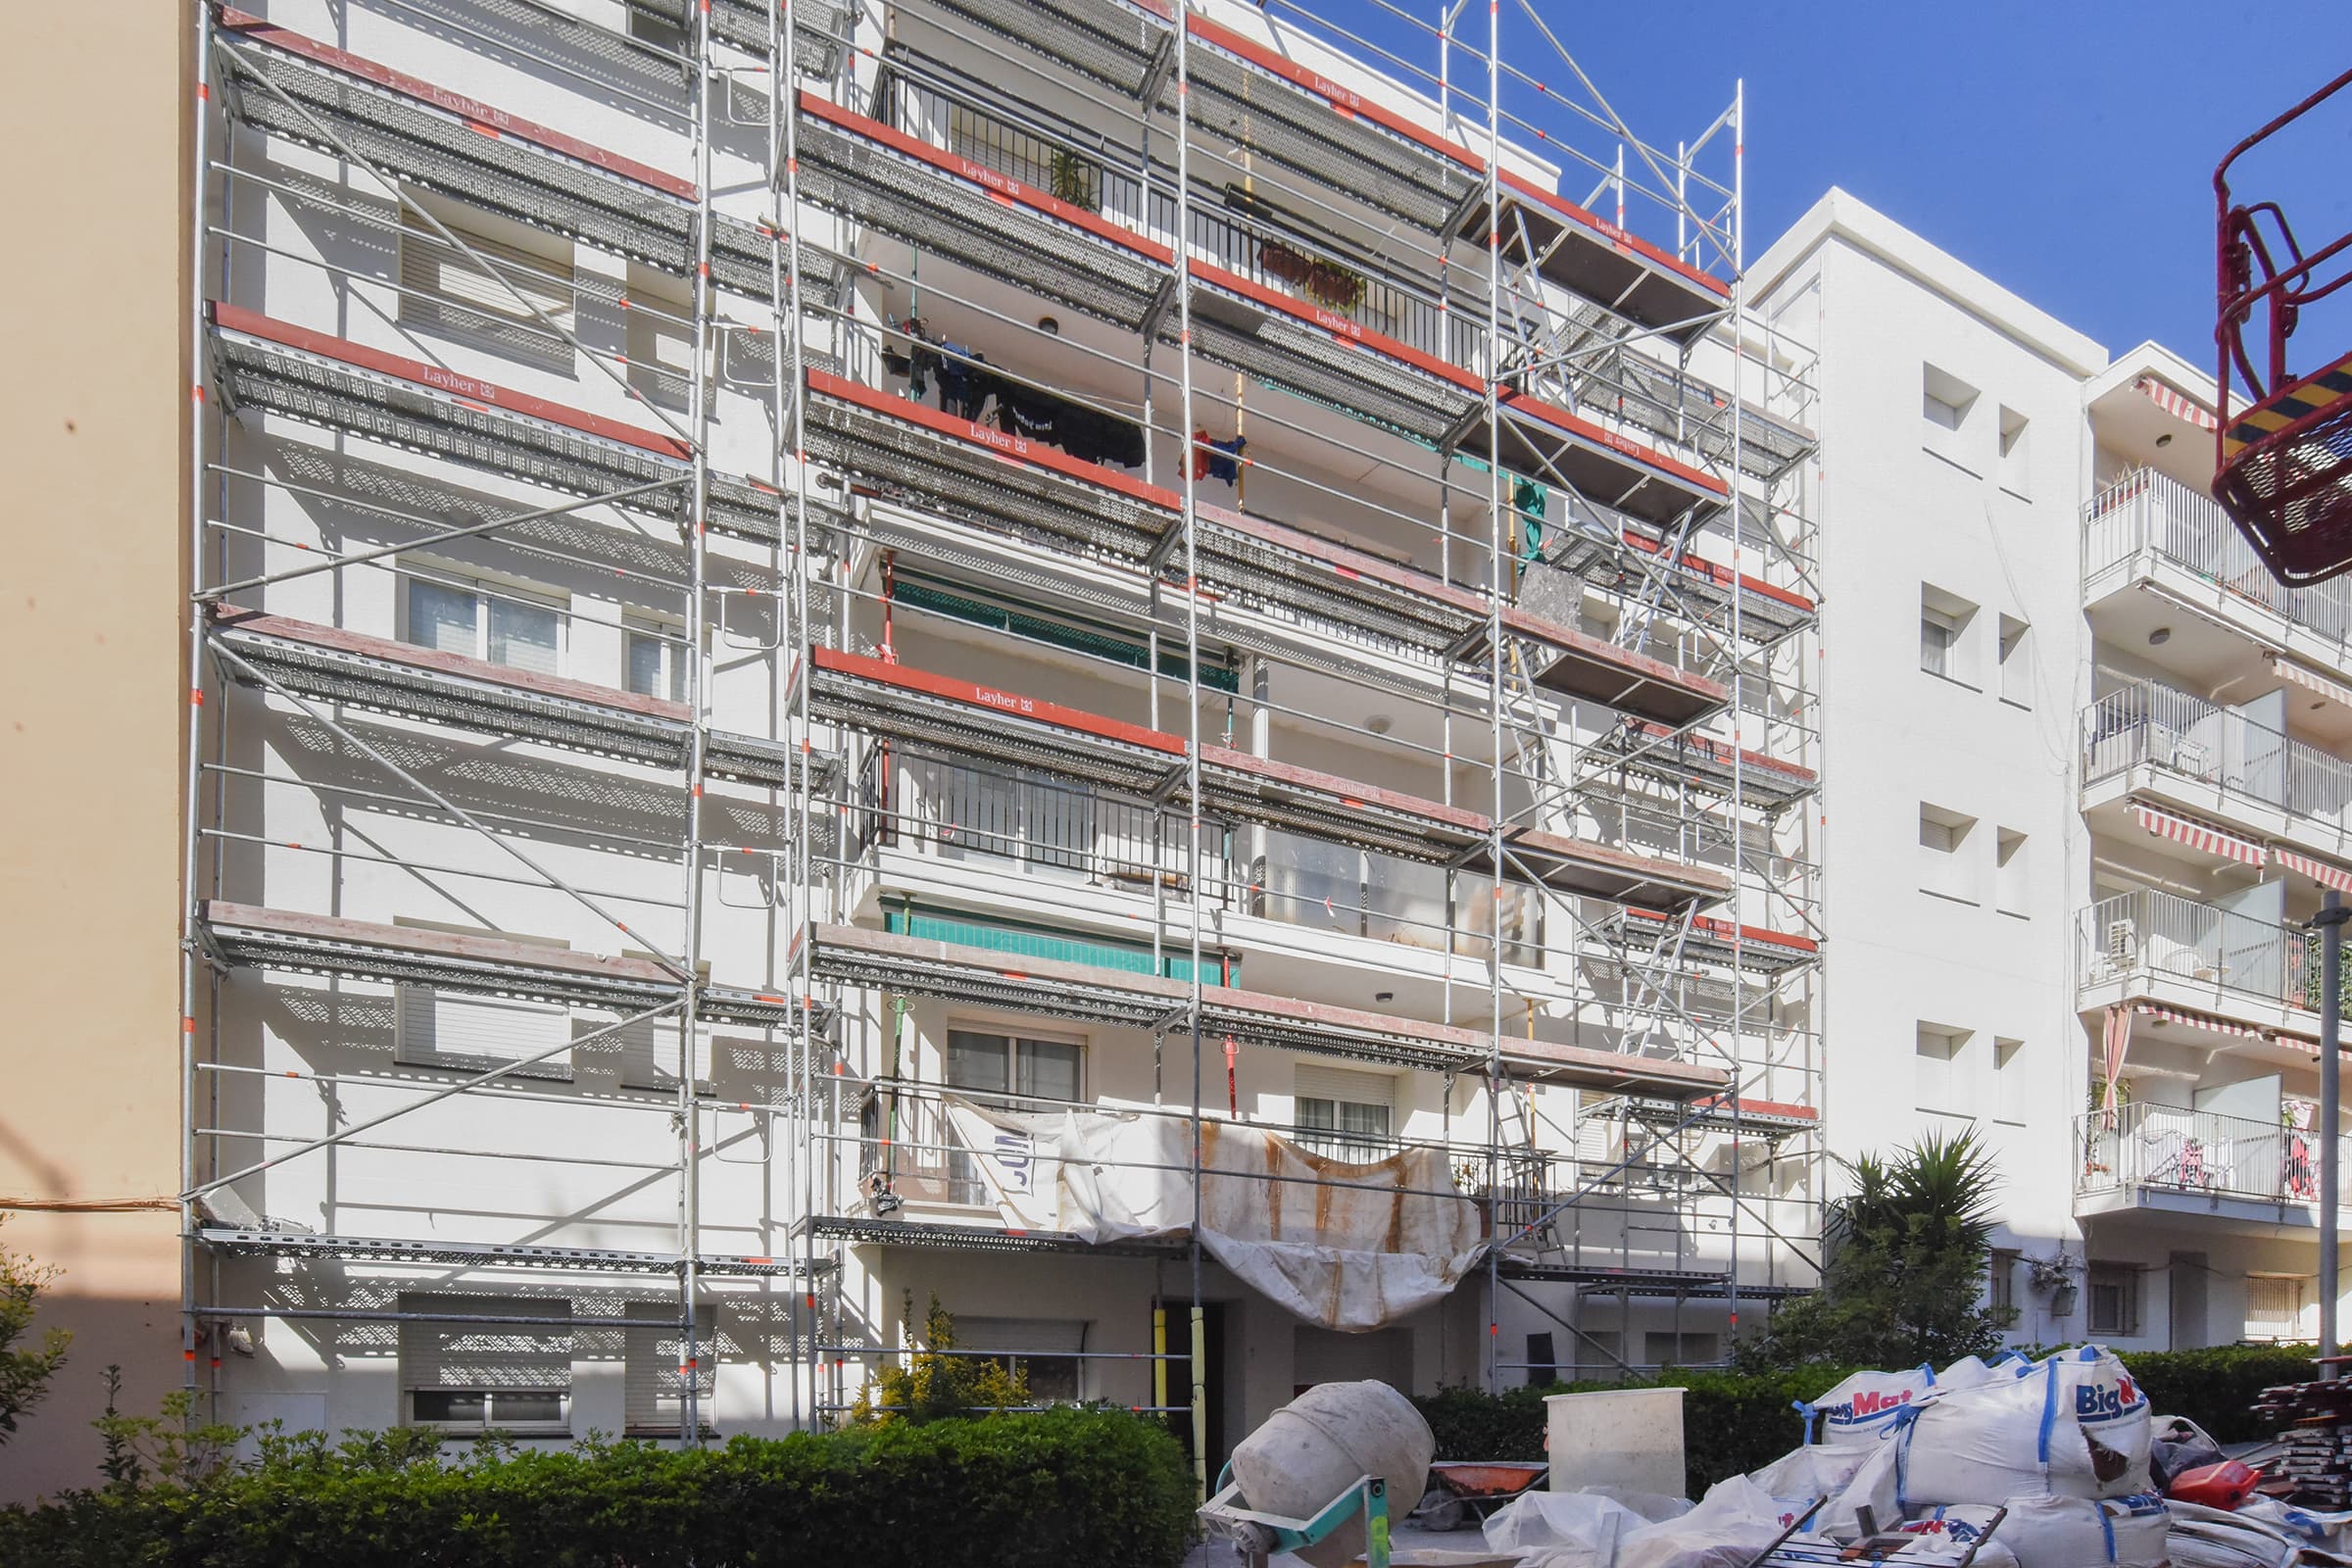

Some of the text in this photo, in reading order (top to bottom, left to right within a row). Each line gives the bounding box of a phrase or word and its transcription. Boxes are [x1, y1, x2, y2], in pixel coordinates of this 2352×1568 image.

[1315, 75, 1347, 100] Layher
[962, 161, 1004, 187] Layher
[1317, 310, 1348, 332] Layher
[423, 366, 475, 392] Layher
[970, 424, 1011, 448] Layher
[975, 687, 1016, 708] Layher
